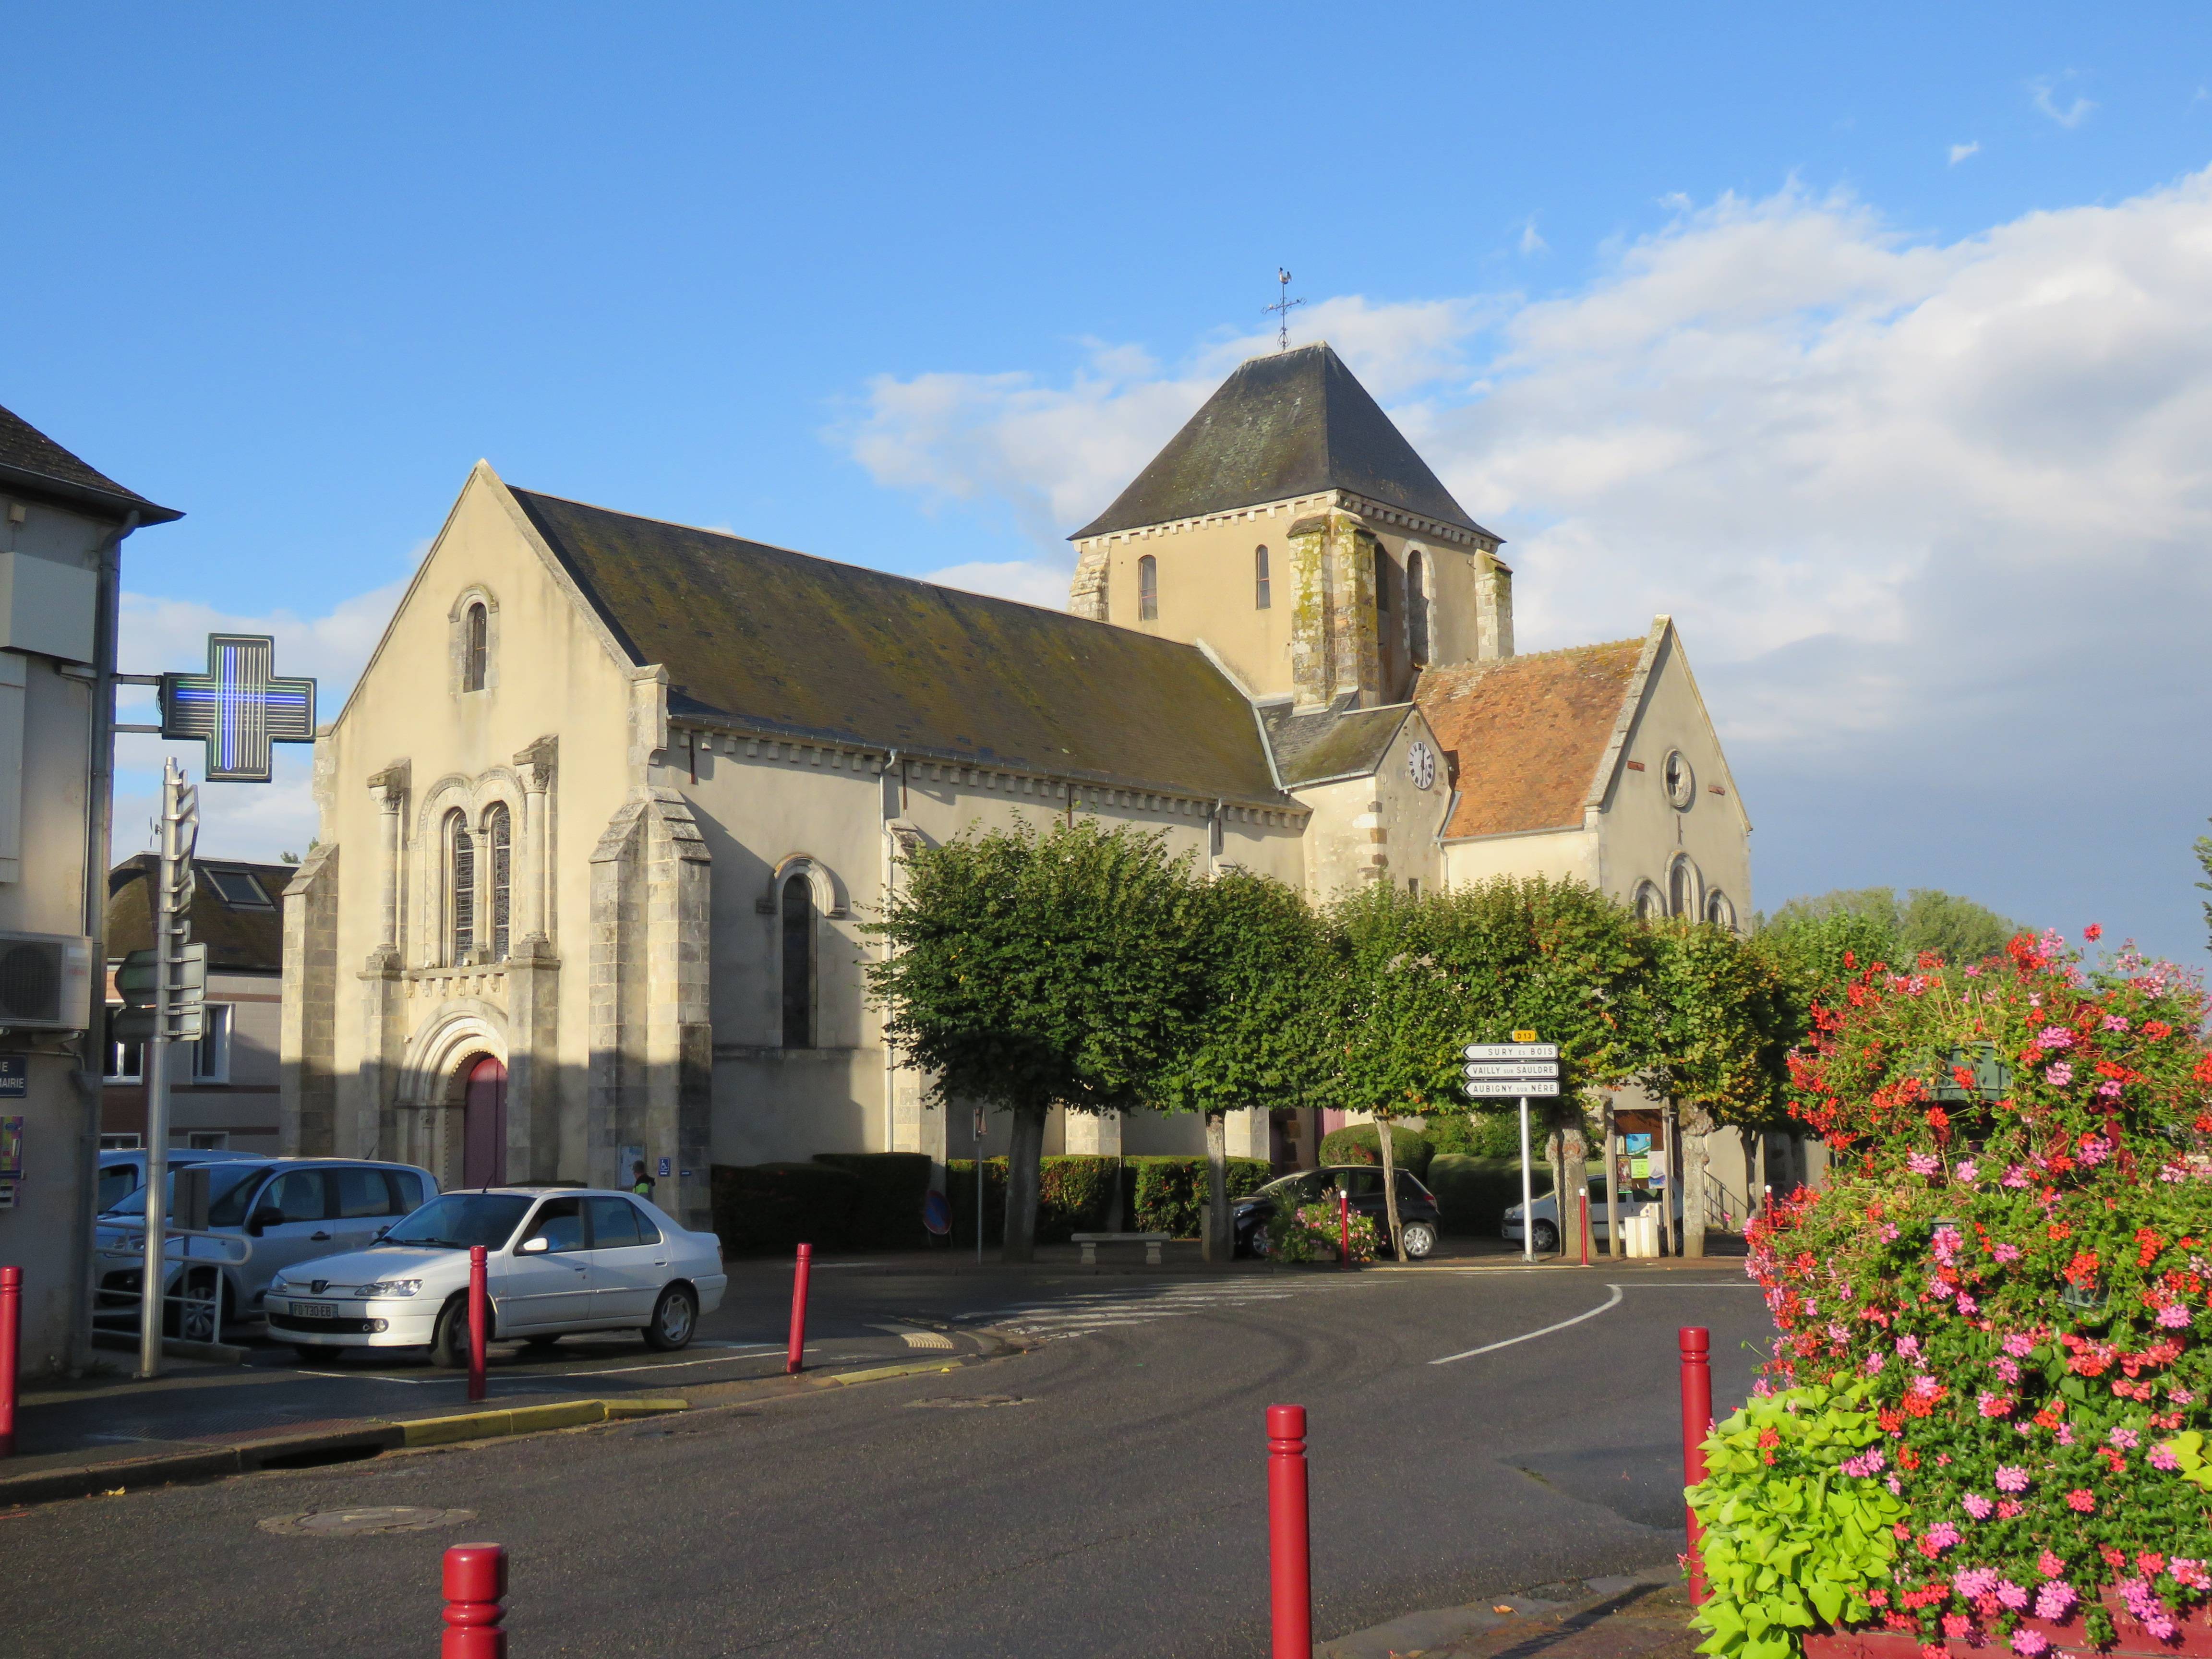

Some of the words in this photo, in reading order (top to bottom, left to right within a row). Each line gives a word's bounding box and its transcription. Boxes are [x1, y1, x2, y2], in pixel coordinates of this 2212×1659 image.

[0, 1061, 8, 1071] E
[1516, 1066, 1553, 1074] SAULDRE
[1531, 1083, 1555, 1092] NÈRE
